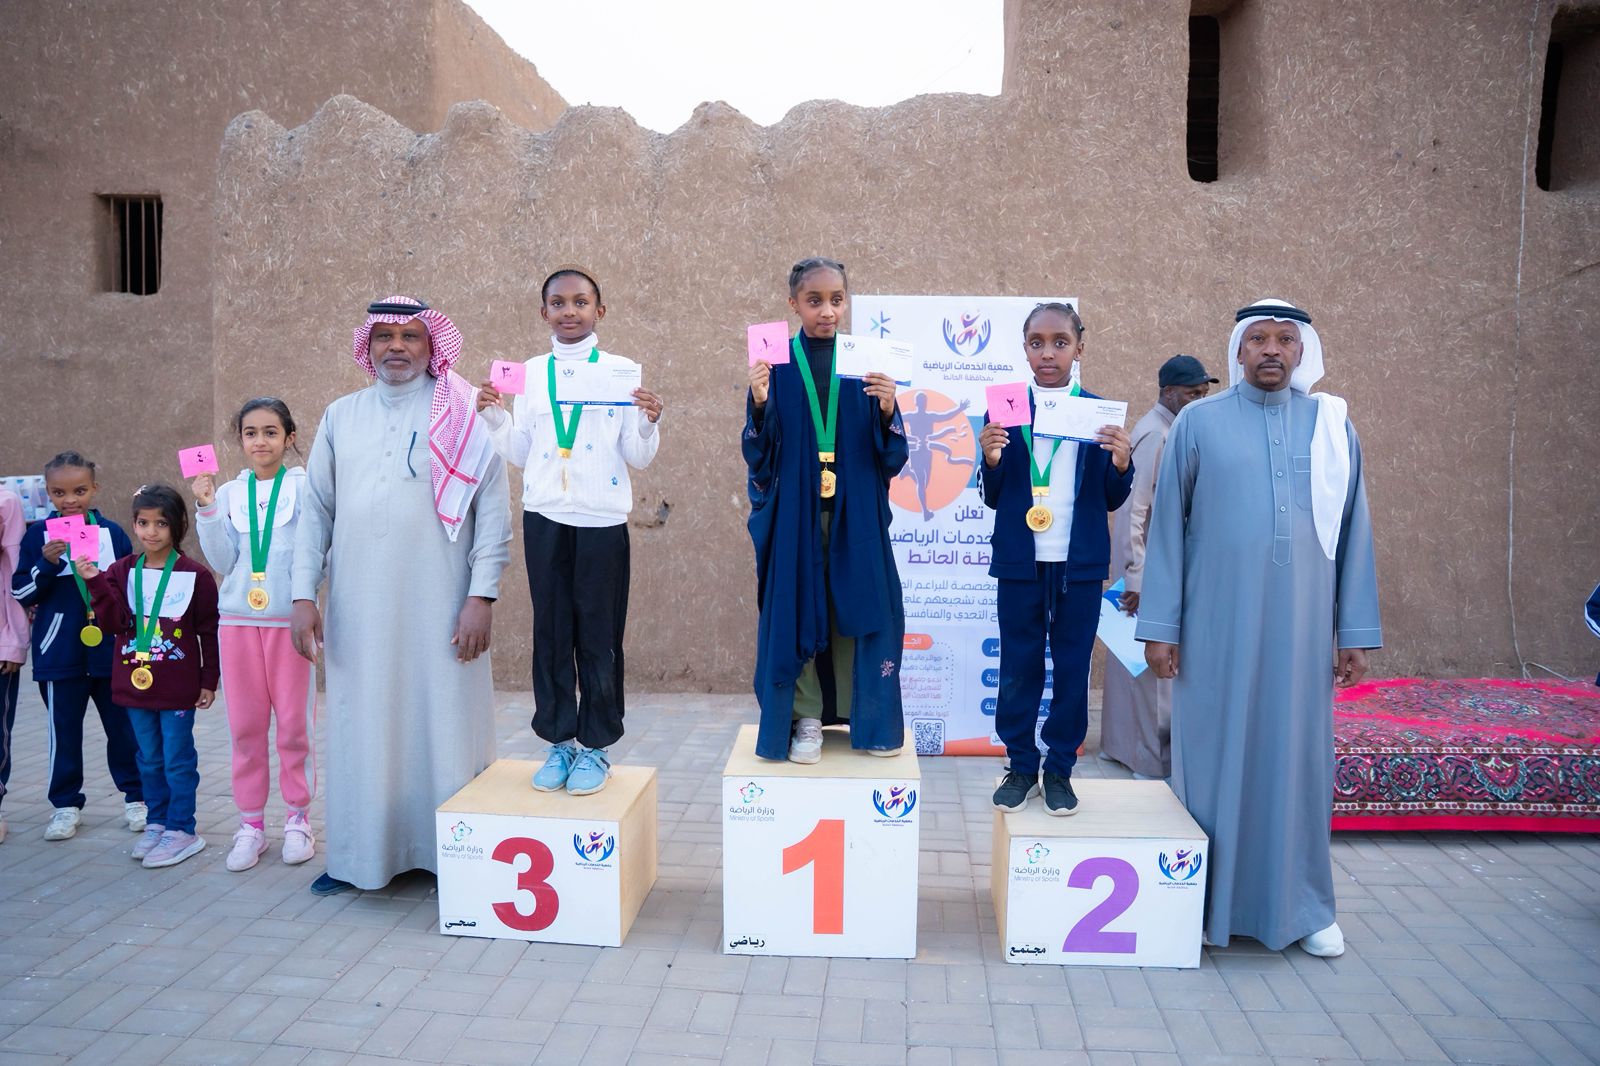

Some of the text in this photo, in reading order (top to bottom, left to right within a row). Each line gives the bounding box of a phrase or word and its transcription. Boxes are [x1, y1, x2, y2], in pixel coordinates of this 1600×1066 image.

[923, 360, 1013, 373] جمعية الخدمات الرياضية
[964, 374, 994, 382] بمحافظة
[955, 505, 984, 522] تعلن
[890, 529, 993, 547] خدمات الرياضي
[908, 549, 958, 565] الحائط
[914, 579, 948, 592] للبراعم
[924, 594, 976, 607] تشجيعهم
[953, 609, 988, 622] التحدي
[729, 806, 775, 816] وزارة الرياضة
[441, 844, 483, 854] وزارة الرياضة
[782, 819, 845, 935] 1
[1014, 866, 1060, 875] وزارة الرياضة
[491, 837, 560, 932] 3
[1062, 857, 1140, 954] 2
[444, 919, 477, 929] صحي
[729, 935, 765, 949] رياضي
[1009, 944, 1047, 956] مجتمع
